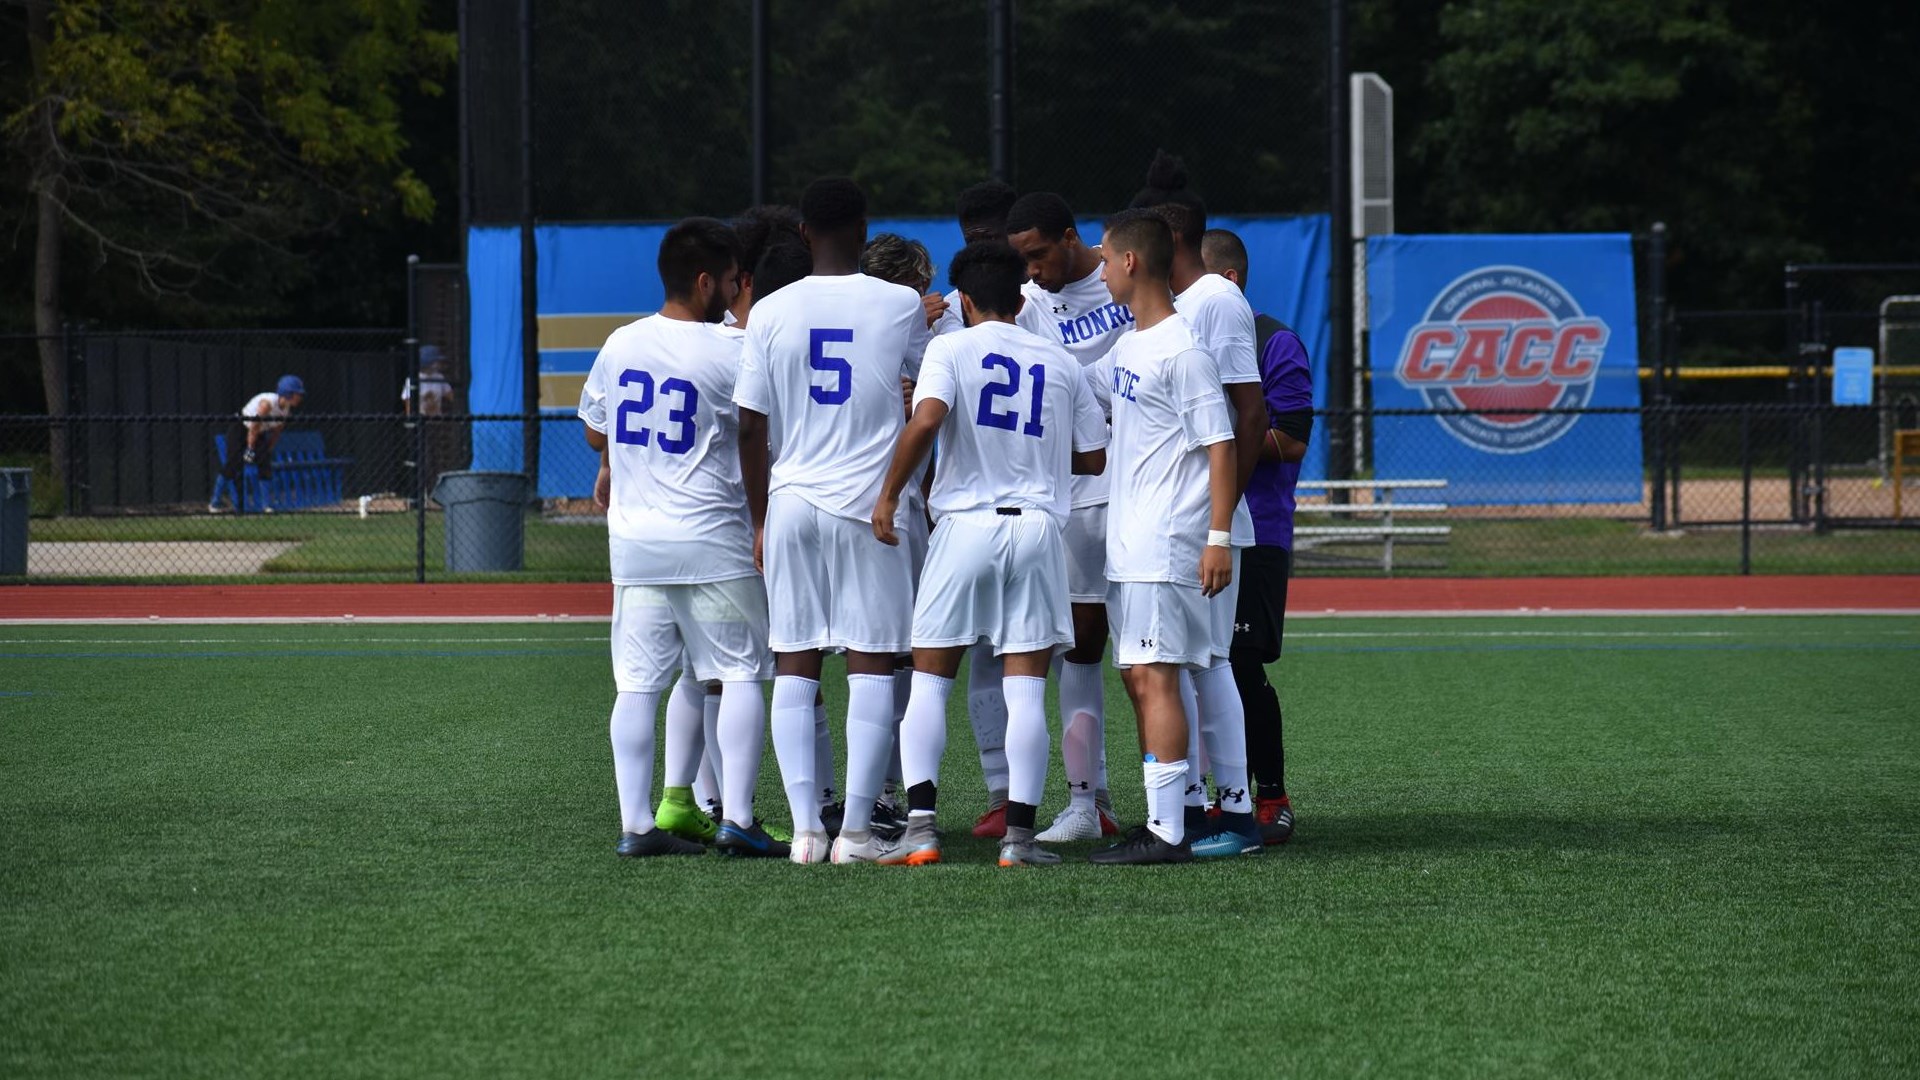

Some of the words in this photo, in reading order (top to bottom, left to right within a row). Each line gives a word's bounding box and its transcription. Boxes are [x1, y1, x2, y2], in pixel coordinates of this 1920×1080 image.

[809, 328, 853, 405] 5
[1400, 324, 1607, 383] CACC
[616, 369, 698, 454] 23
[976, 352, 1045, 438] 21
